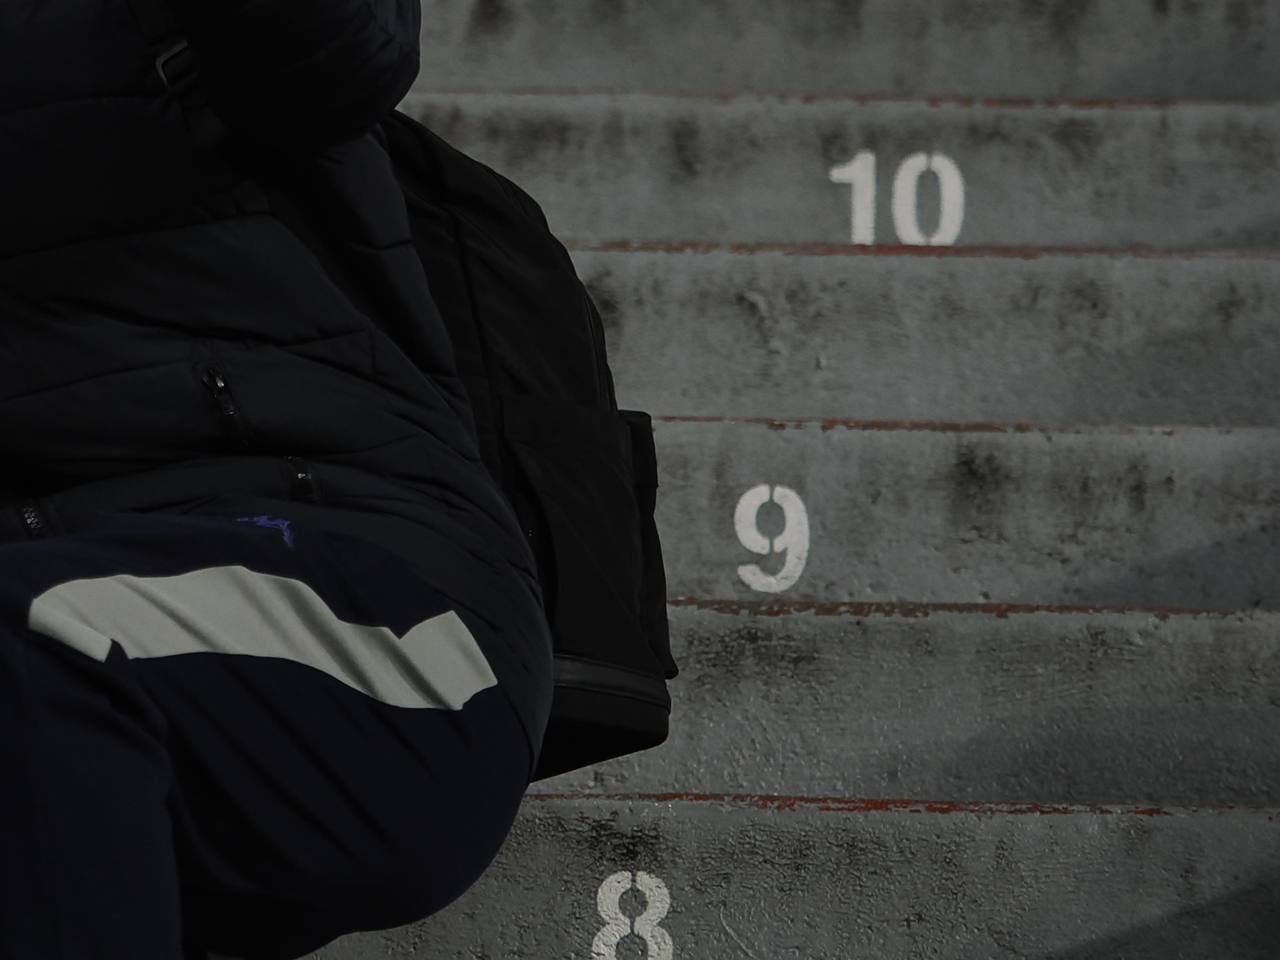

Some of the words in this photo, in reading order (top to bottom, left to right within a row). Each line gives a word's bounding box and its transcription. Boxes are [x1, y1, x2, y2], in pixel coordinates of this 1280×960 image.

[829, 151, 966, 246] 10
[733, 483, 811, 593] 9
[591, 870, 675, 960] 8
